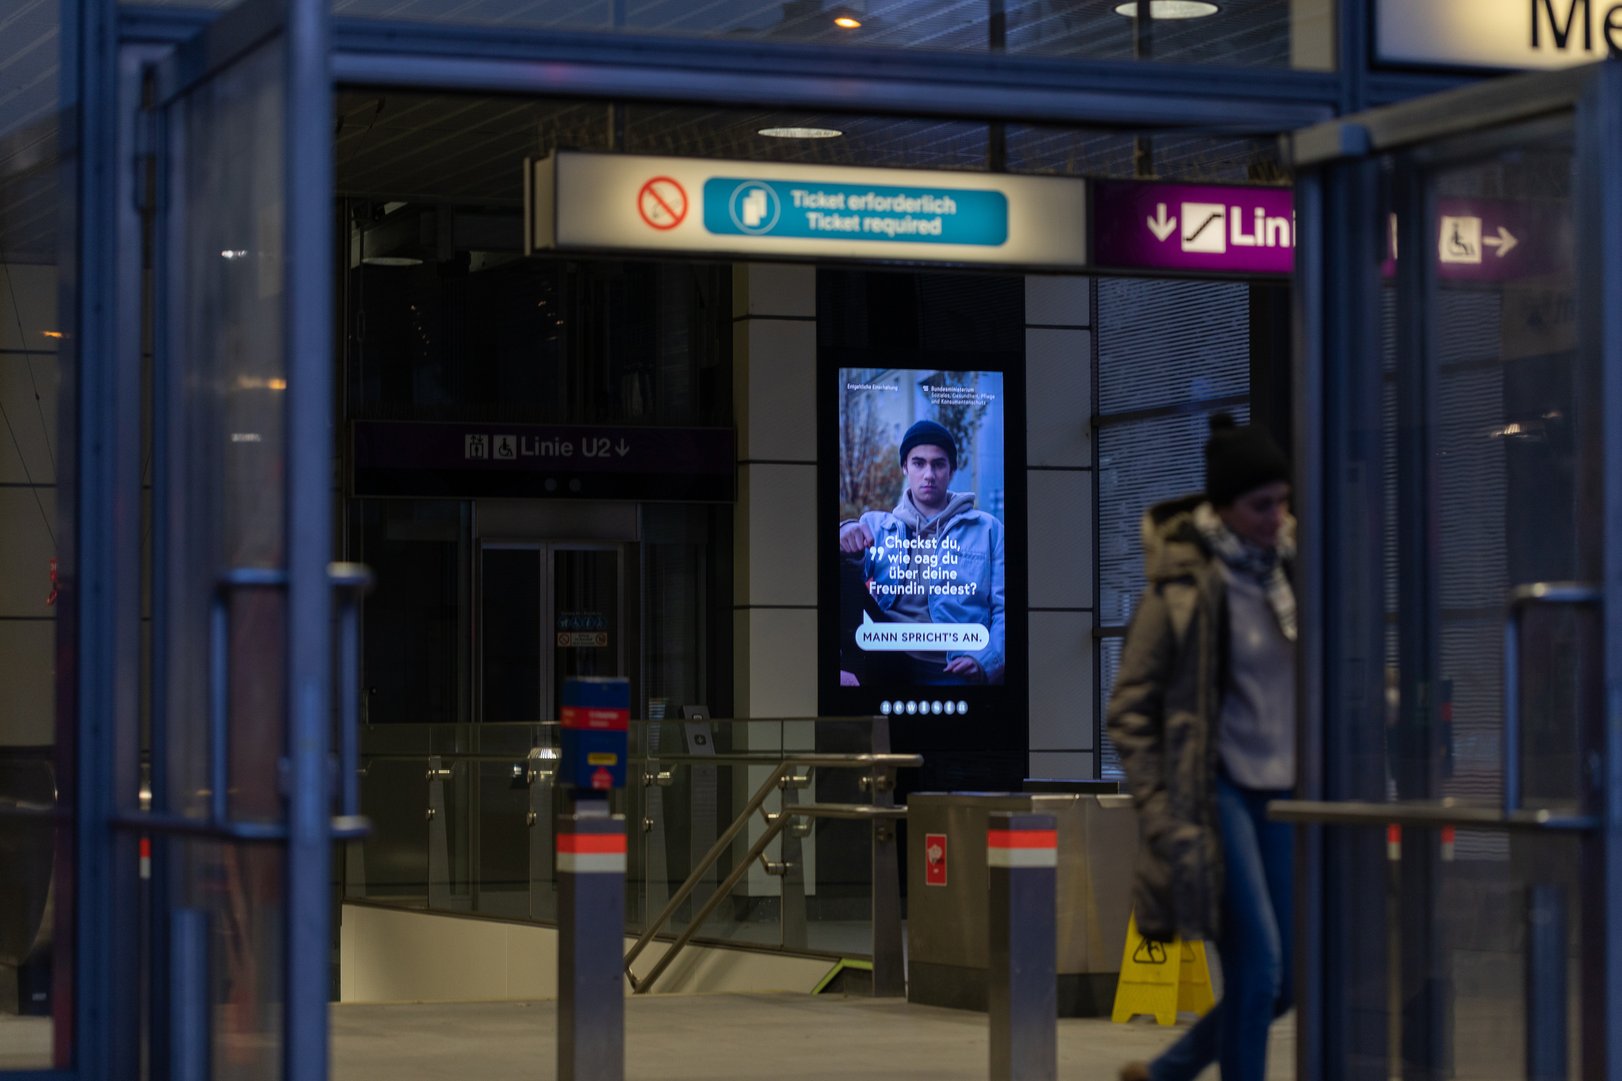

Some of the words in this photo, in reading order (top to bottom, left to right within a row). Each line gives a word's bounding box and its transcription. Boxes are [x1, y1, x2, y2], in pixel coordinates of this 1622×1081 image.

[791, 190, 844, 209] Ticket
[848, 192, 957, 215] erforderlich
[807, 212, 861, 232] Ticket
[863, 215, 942, 237] required
[1230, 205, 1296, 248] Lin
[520, 436, 574, 457] Linie
[582, 437, 611, 458] U2
[885, 535, 937, 549] Checkst
[941, 536, 961, 551] du,
[888, 551, 911, 564] wie
[914, 554, 938, 567] oag
[942, 551, 958, 565] du
[889, 566, 918, 579] über
[922, 567, 958, 580] deine
[869, 582, 925, 595] Freundin
[929, 583, 977, 595] redest?
[863, 632, 898, 642] MANN
[962, 633, 983, 642] AN.
